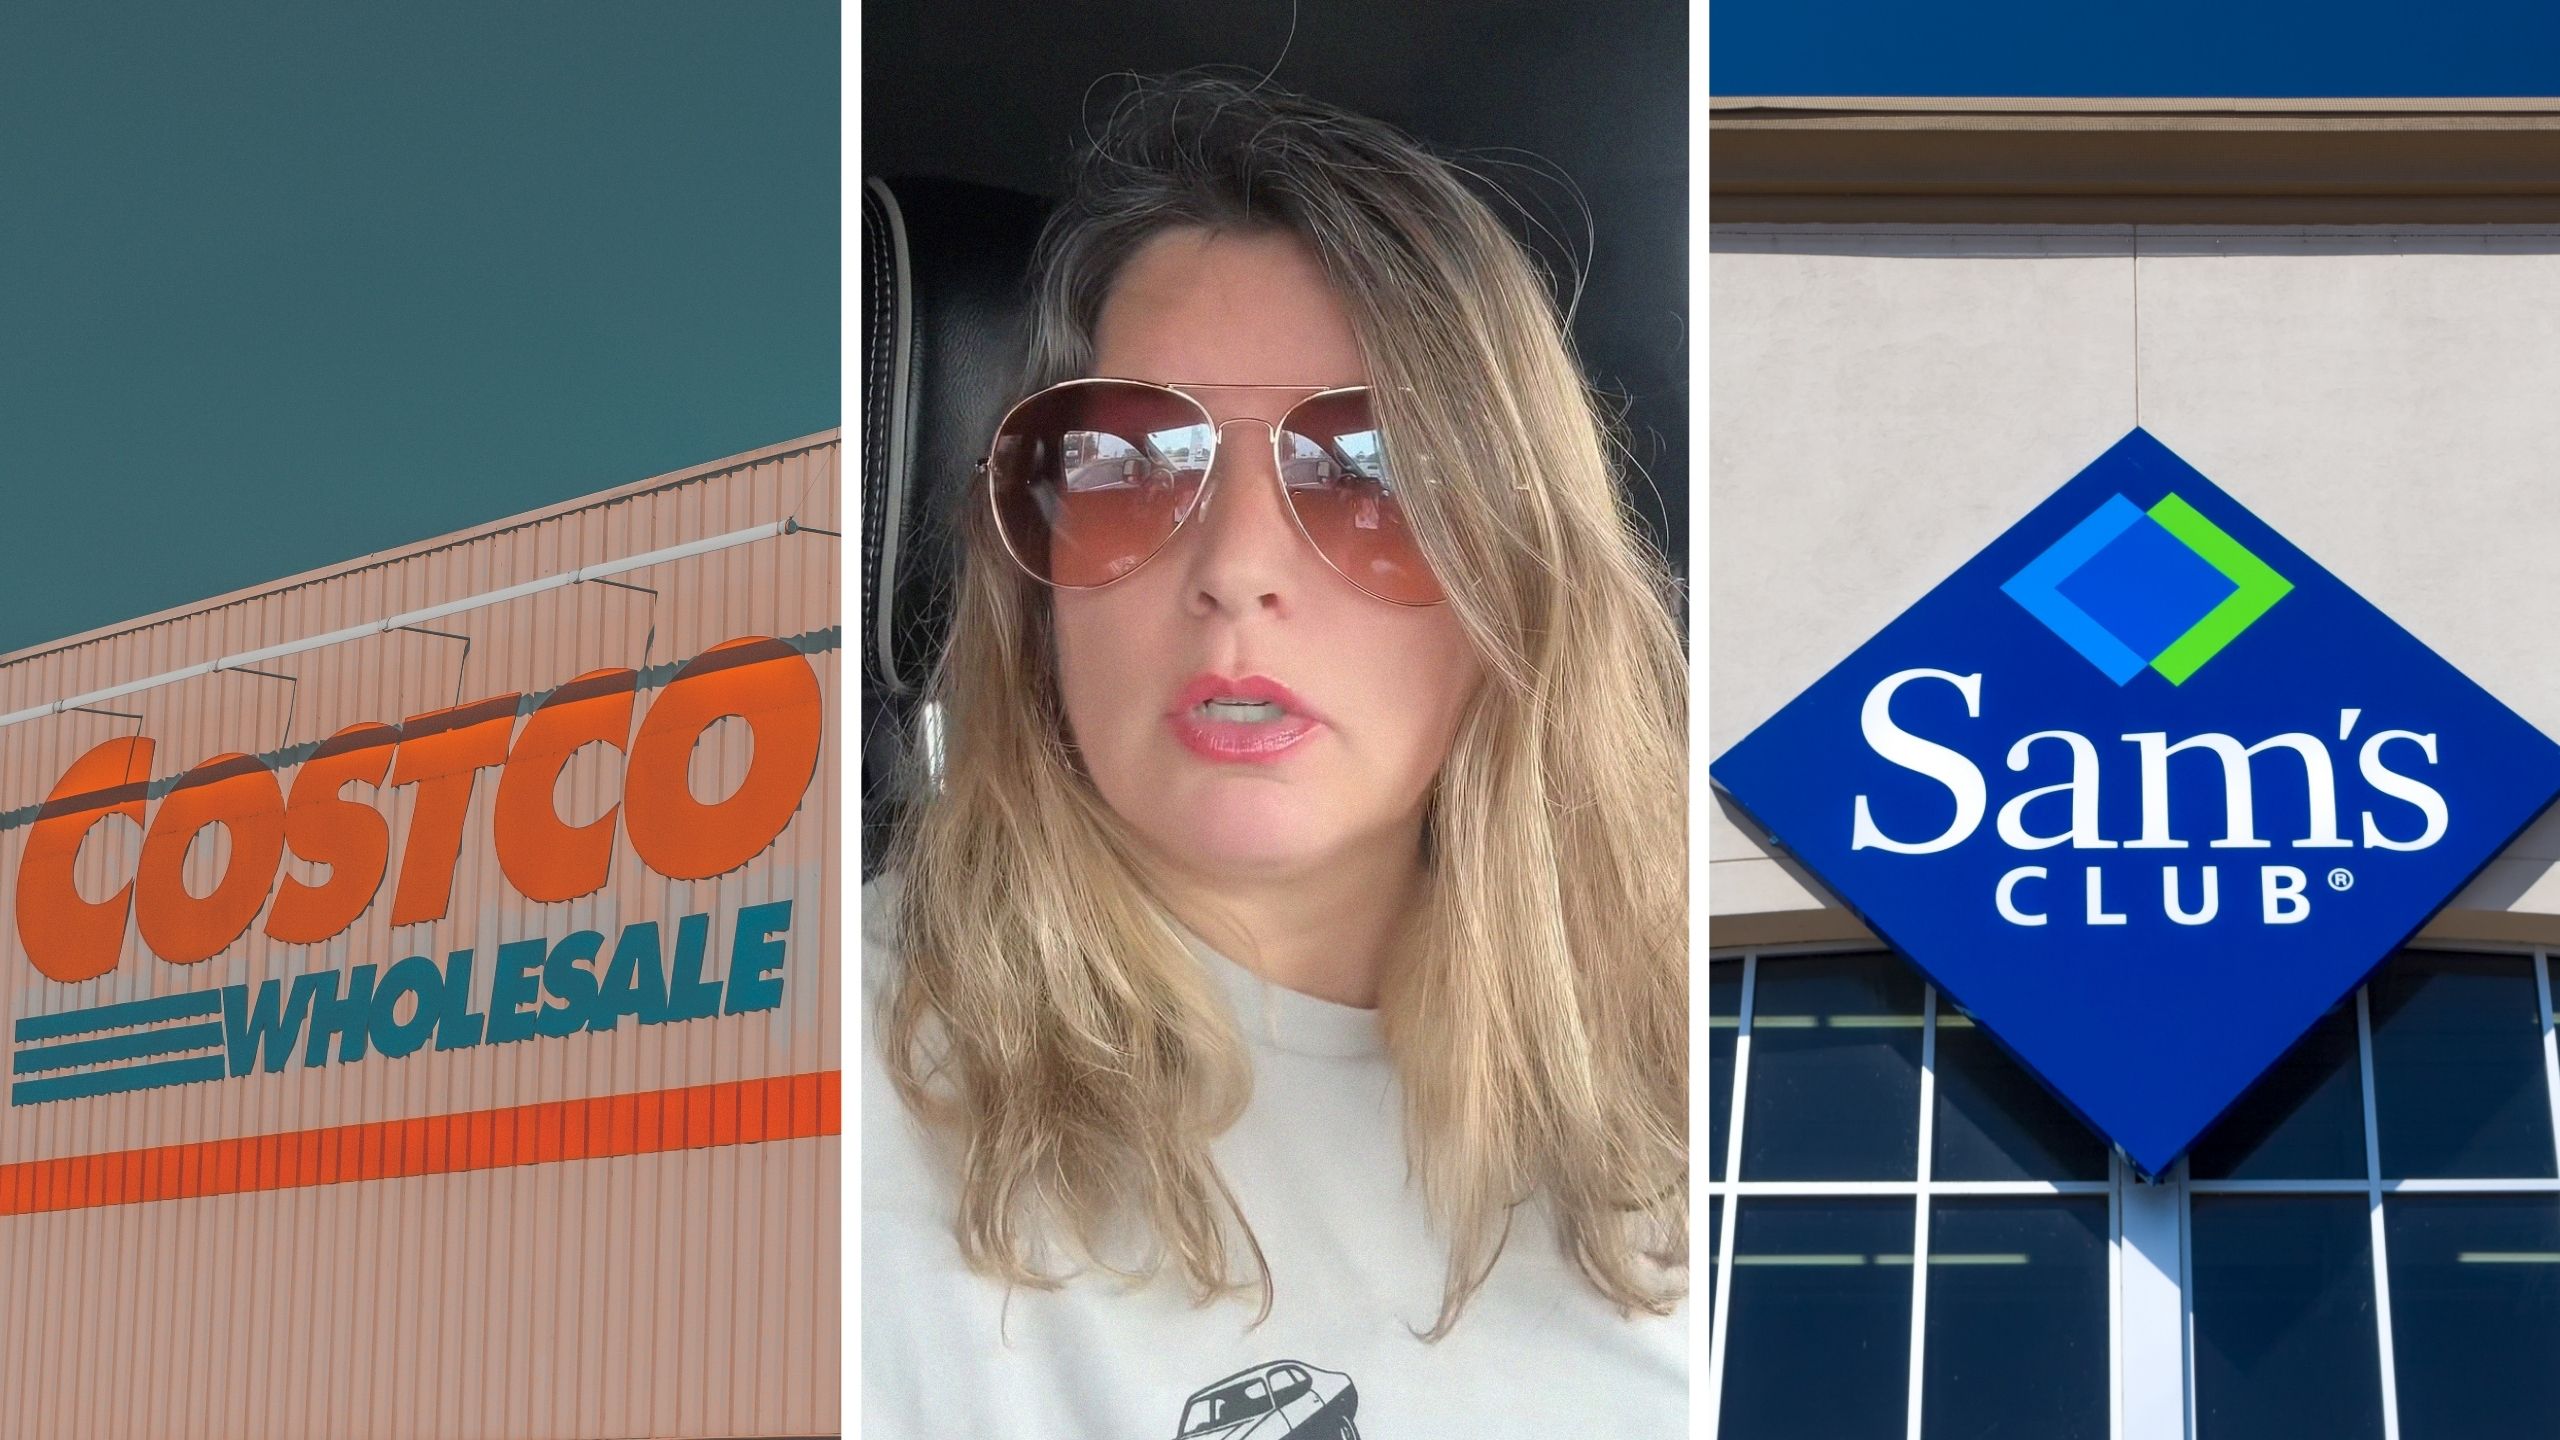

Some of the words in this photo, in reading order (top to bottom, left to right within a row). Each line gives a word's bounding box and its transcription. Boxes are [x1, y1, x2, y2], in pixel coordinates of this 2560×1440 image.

[16, 635, 822, 983] COSTCO
[1851, 668, 2449, 854] Sam's
[221, 900, 793, 1078] WHOLESALE
